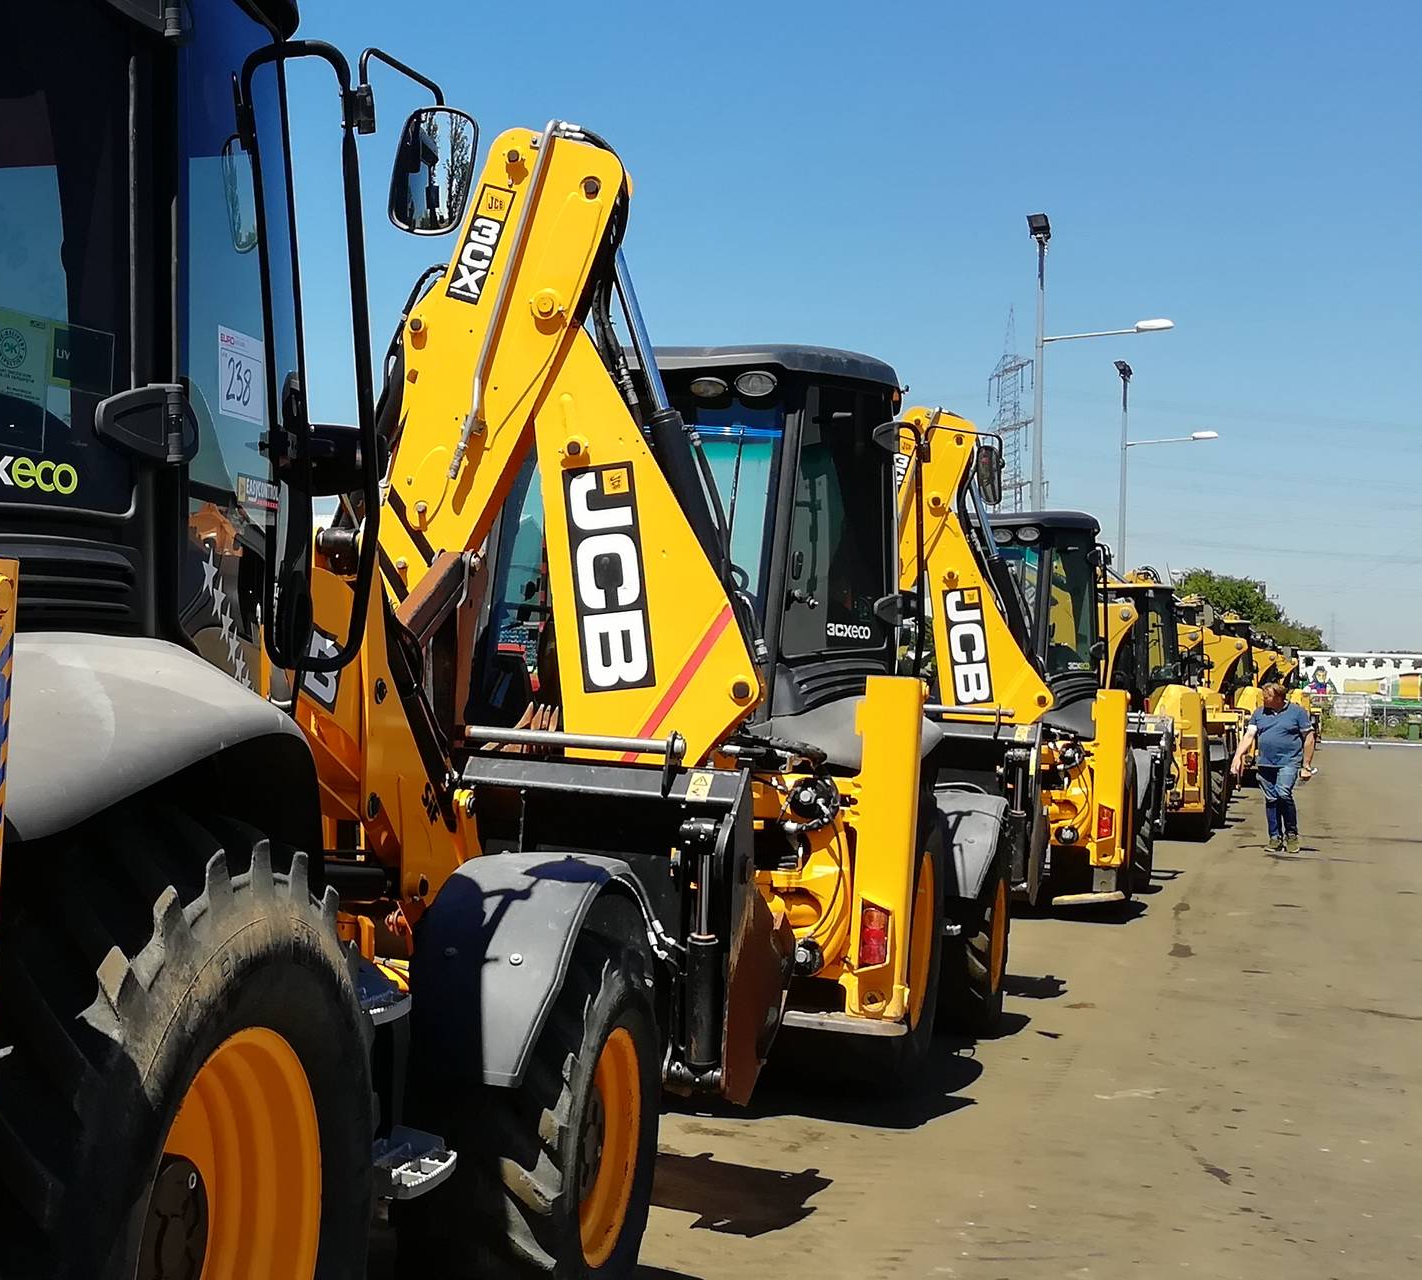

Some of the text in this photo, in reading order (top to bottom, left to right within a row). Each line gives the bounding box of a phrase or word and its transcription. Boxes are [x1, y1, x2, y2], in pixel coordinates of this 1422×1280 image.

[450, 218, 501, 295] 3CX
[226, 357, 252, 406] 238
[569, 471, 648, 687] JCB
[826, 623, 871, 639] 3CXeco
[946, 590, 990, 703] JCB
